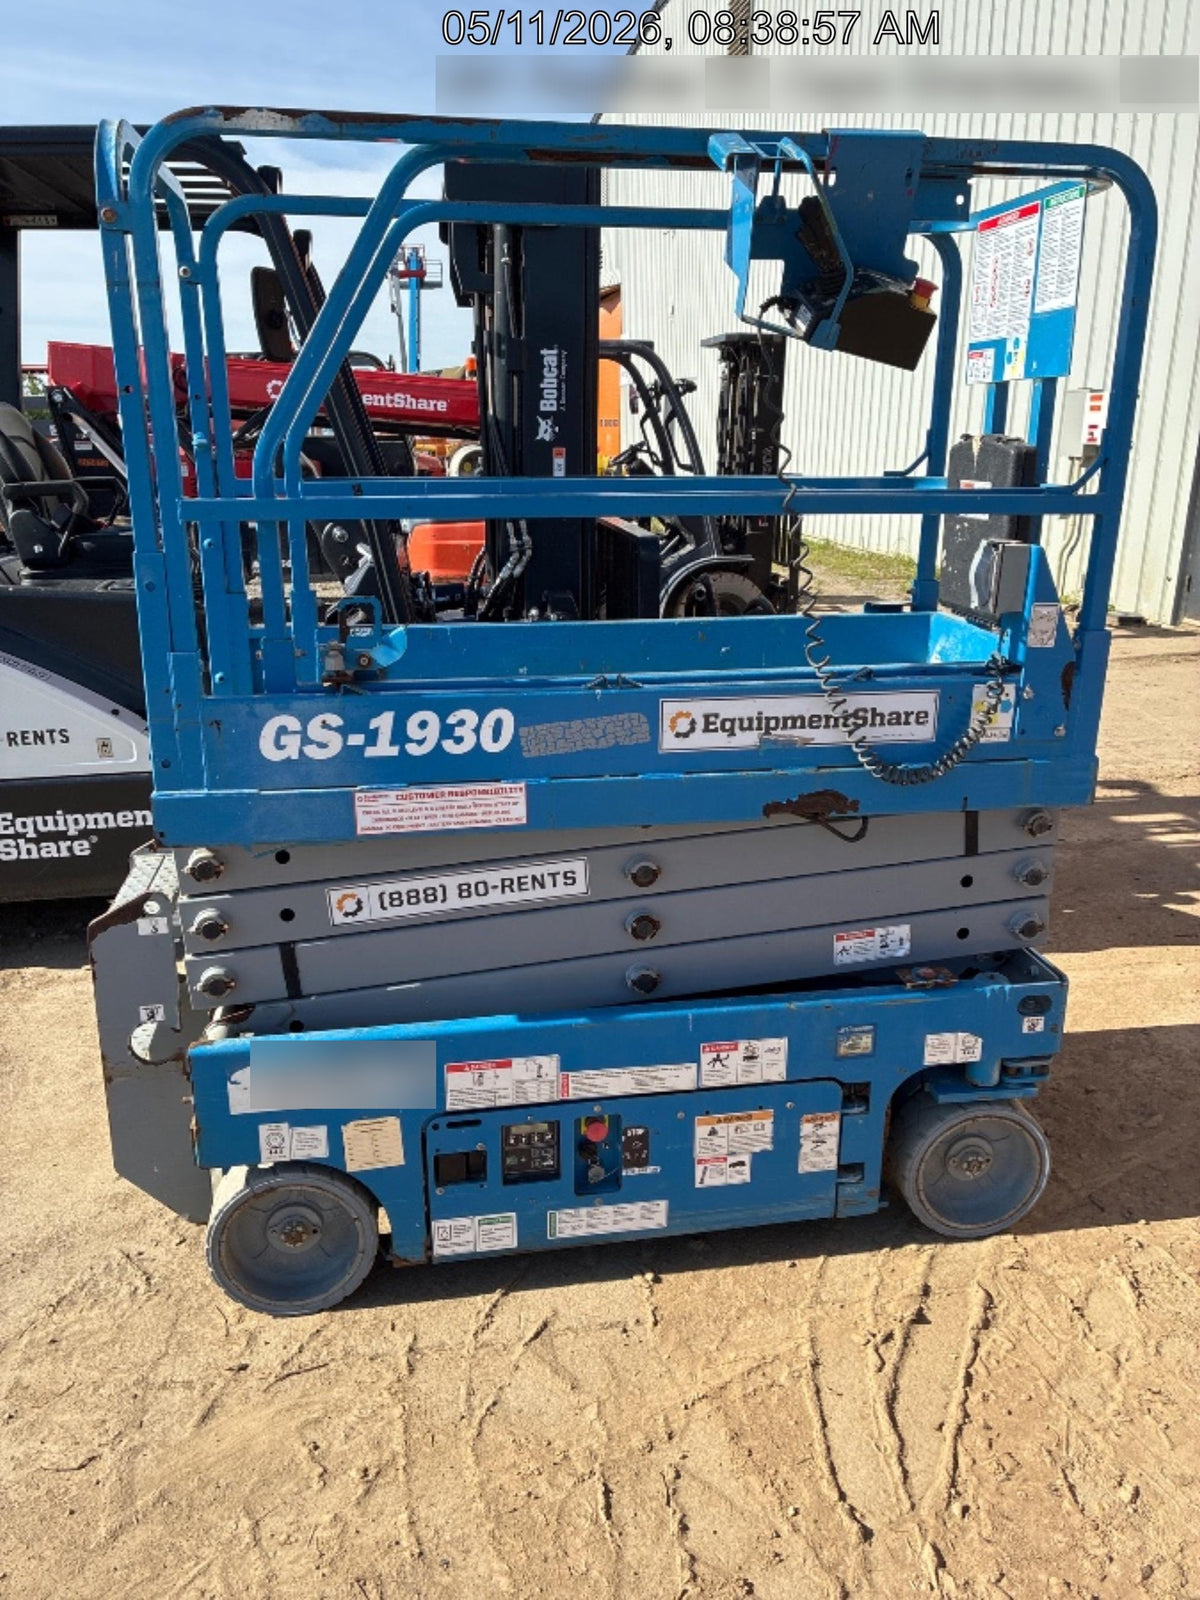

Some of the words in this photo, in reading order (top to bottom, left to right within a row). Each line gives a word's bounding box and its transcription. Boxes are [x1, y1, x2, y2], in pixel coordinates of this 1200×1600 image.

[540, 348, 559, 411] Bobcat
[361, 392, 447, 412] entShare
[259, 708, 515, 762] GS-1930
[702, 707, 929, 736] EquipmentShare
[6, 728, 70, 747] RENTS
[0, 809, 153, 838] Equipmen
[378, 884, 447, 911] (888)
[458, 870, 577, 899] 80-RENTS
